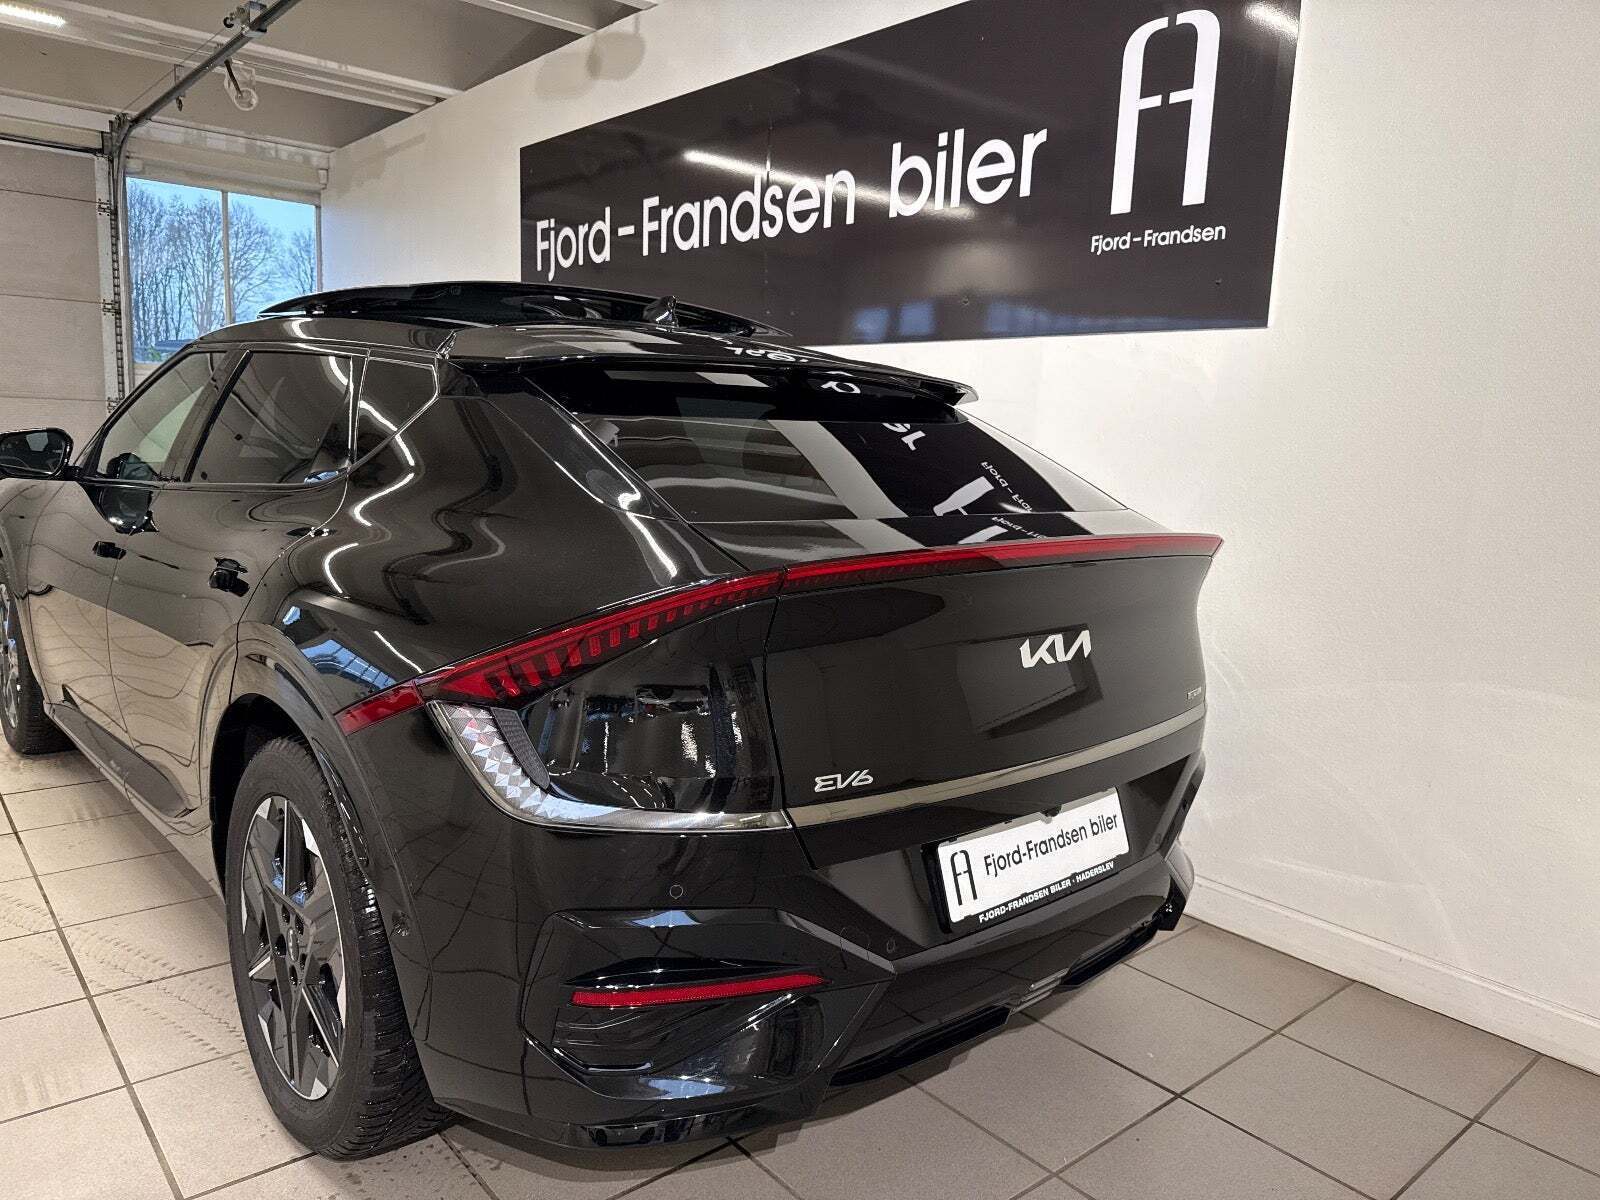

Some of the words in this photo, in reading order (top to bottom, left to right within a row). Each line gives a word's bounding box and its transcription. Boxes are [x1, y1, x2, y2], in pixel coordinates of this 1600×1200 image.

[890, 128, 1048, 218] biler
[814, 769, 874, 793] EV6
[984, 825, 1088, 878] Fjord-Frandsen
[1090, 813, 1118, 837] biler
[978, 888, 1050, 924] FJORD-FRANDSEN
[1050, 878, 1072, 895] BILER
[1075, 860, 1114, 884] HADERSLEV
